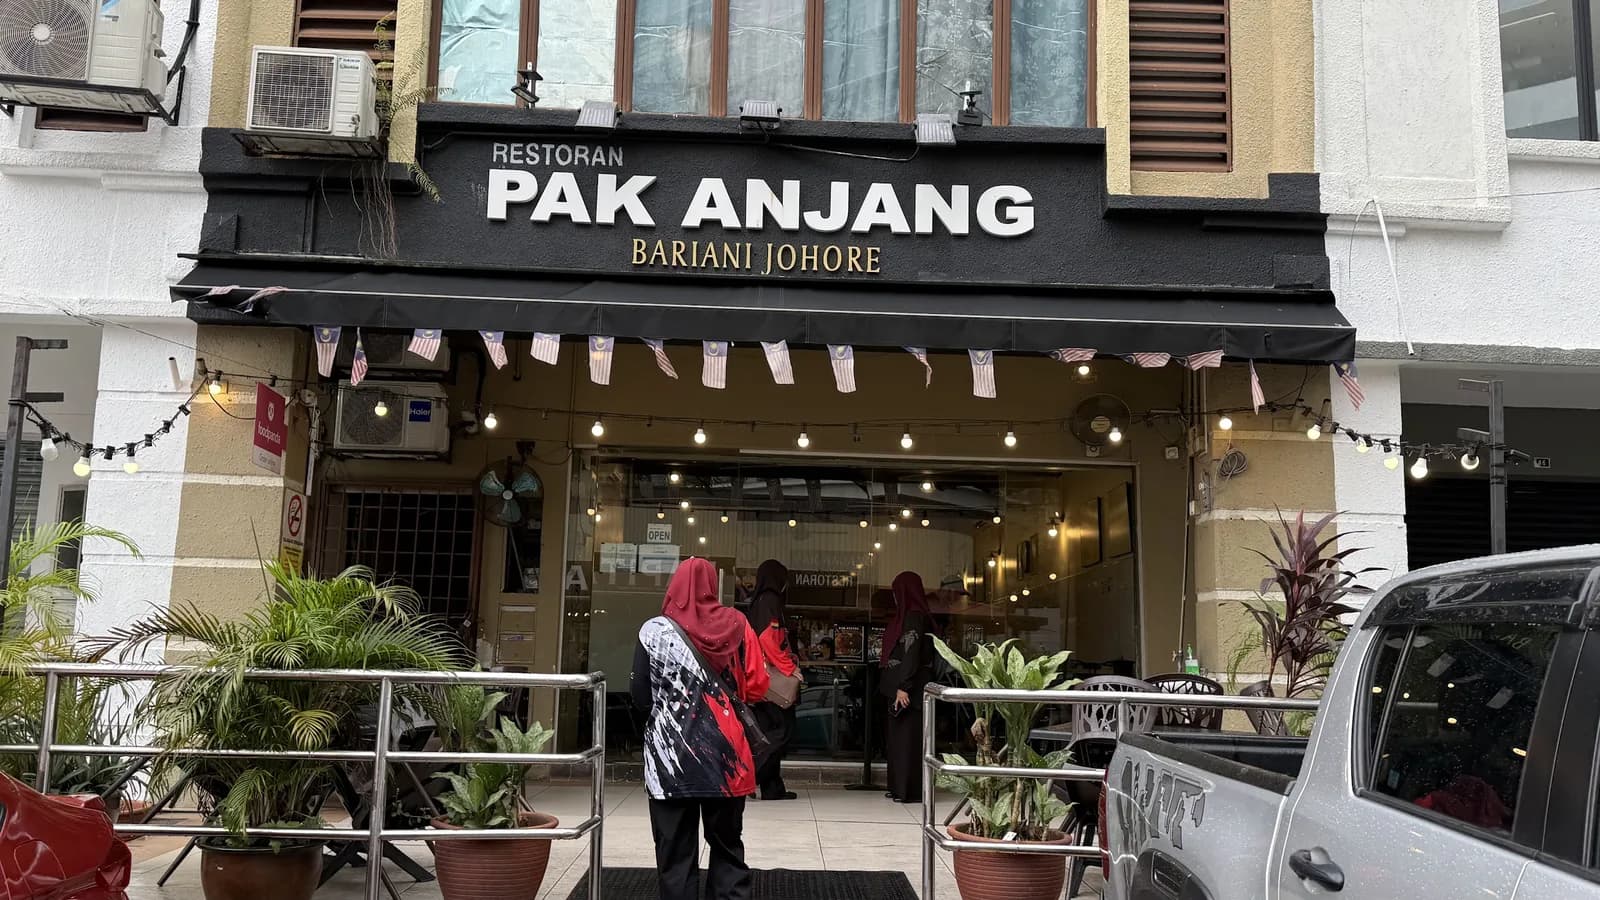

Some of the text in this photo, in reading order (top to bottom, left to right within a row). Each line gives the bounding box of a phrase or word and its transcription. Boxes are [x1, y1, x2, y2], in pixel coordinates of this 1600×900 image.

[492, 142, 623, 167] RESTORAN
[487, 169, 1035, 238] PAK ANJANG
[631, 238, 881, 275] BARIANI JOHORE
[409, 408, 431, 417] Haier
[257, 421, 281, 445] foodpanda
[649, 530, 671, 541] OPEN
